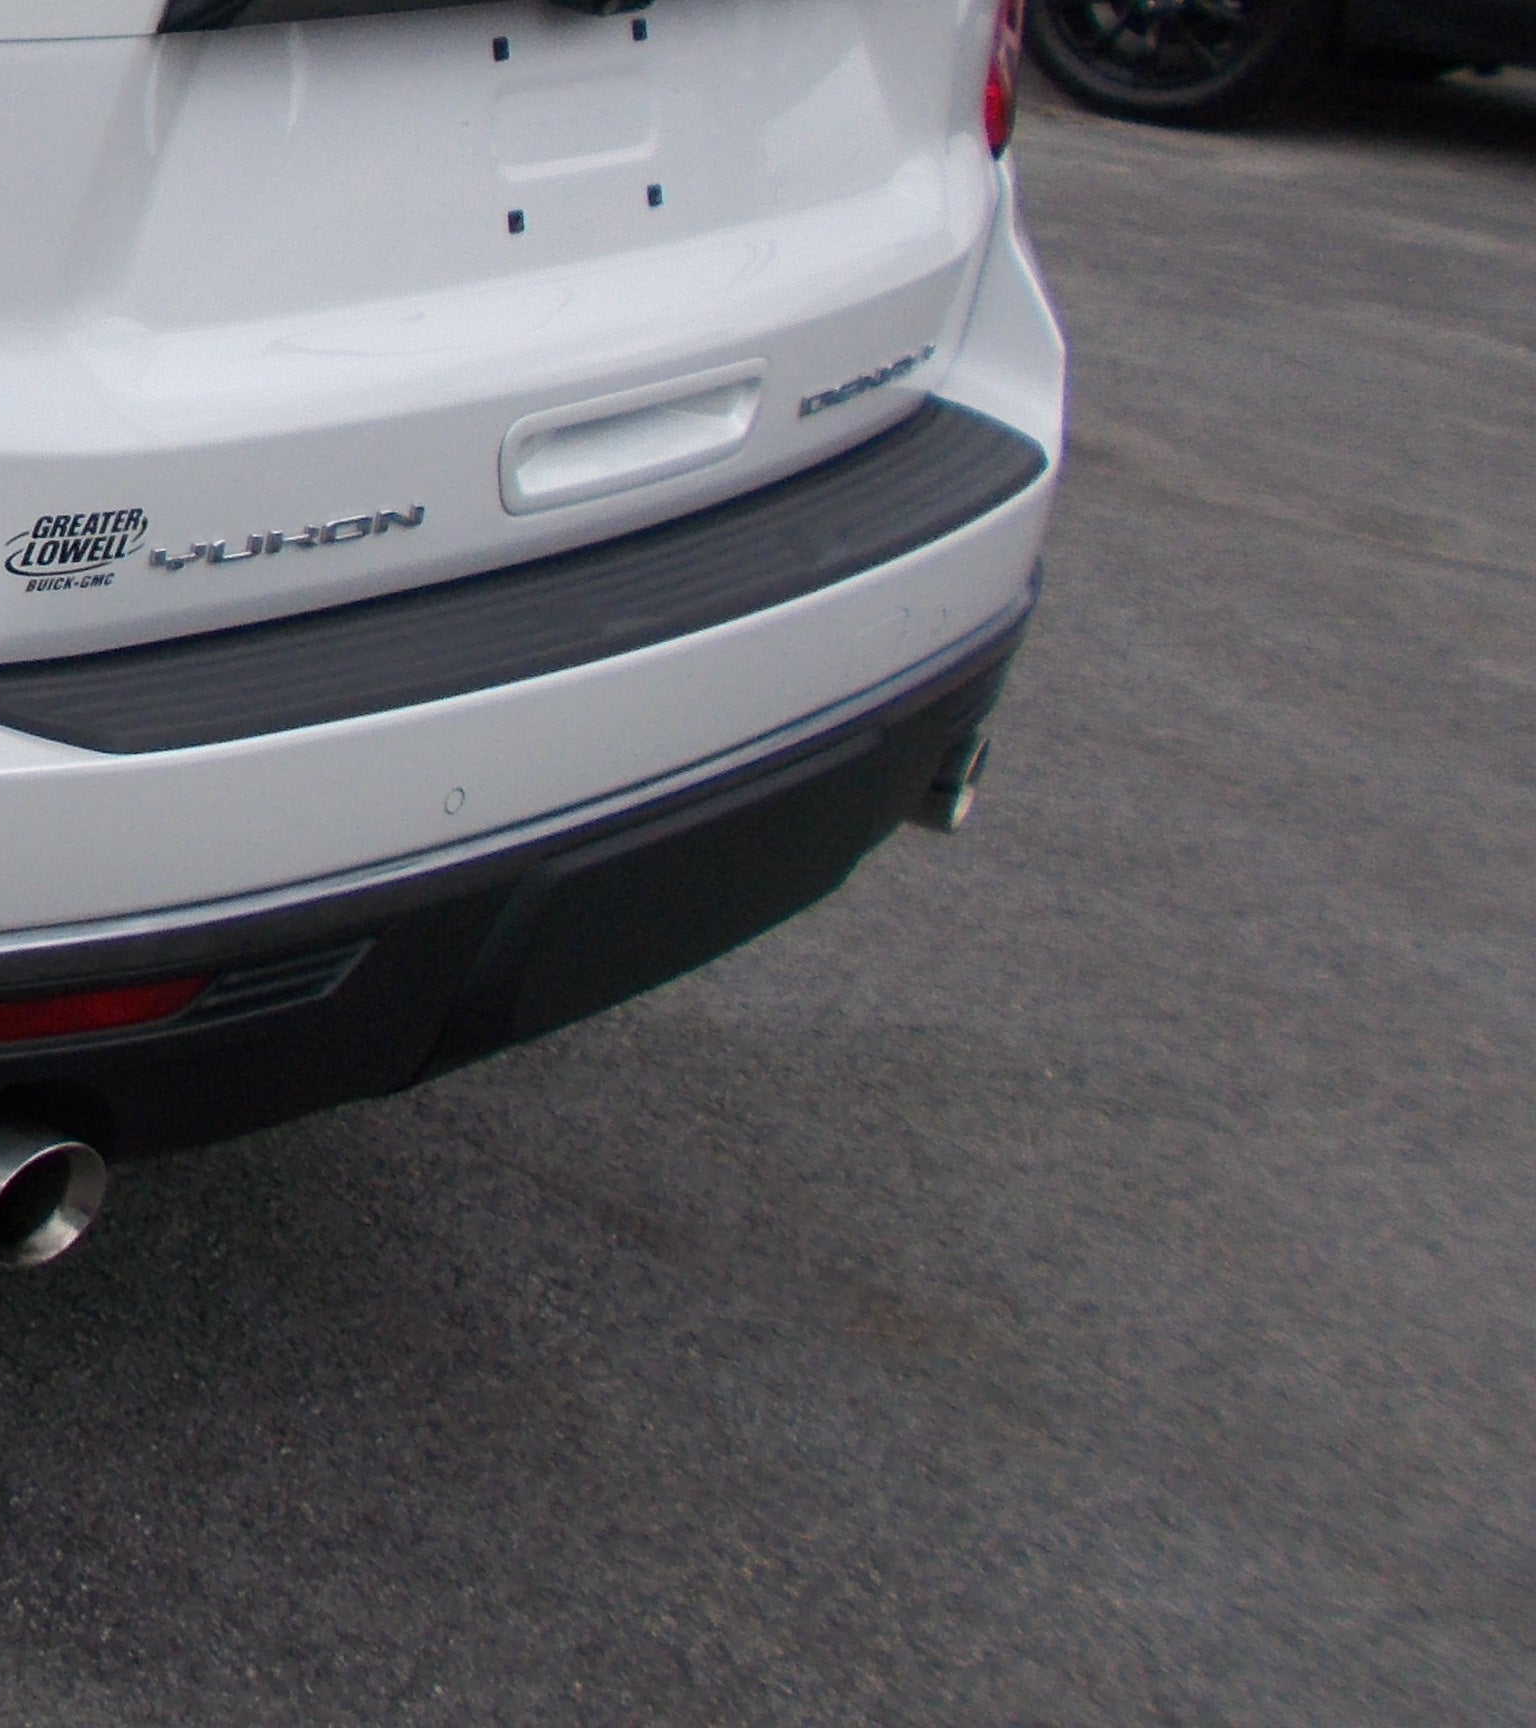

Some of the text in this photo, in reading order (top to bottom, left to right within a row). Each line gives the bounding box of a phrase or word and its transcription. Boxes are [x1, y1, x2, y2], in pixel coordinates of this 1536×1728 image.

[31, 507, 144, 539] GREATER
[147, 501, 426, 571] YUKON
[20, 533, 129, 567] LOWELL
[25, 572, 115, 593] BUICK-GMC
